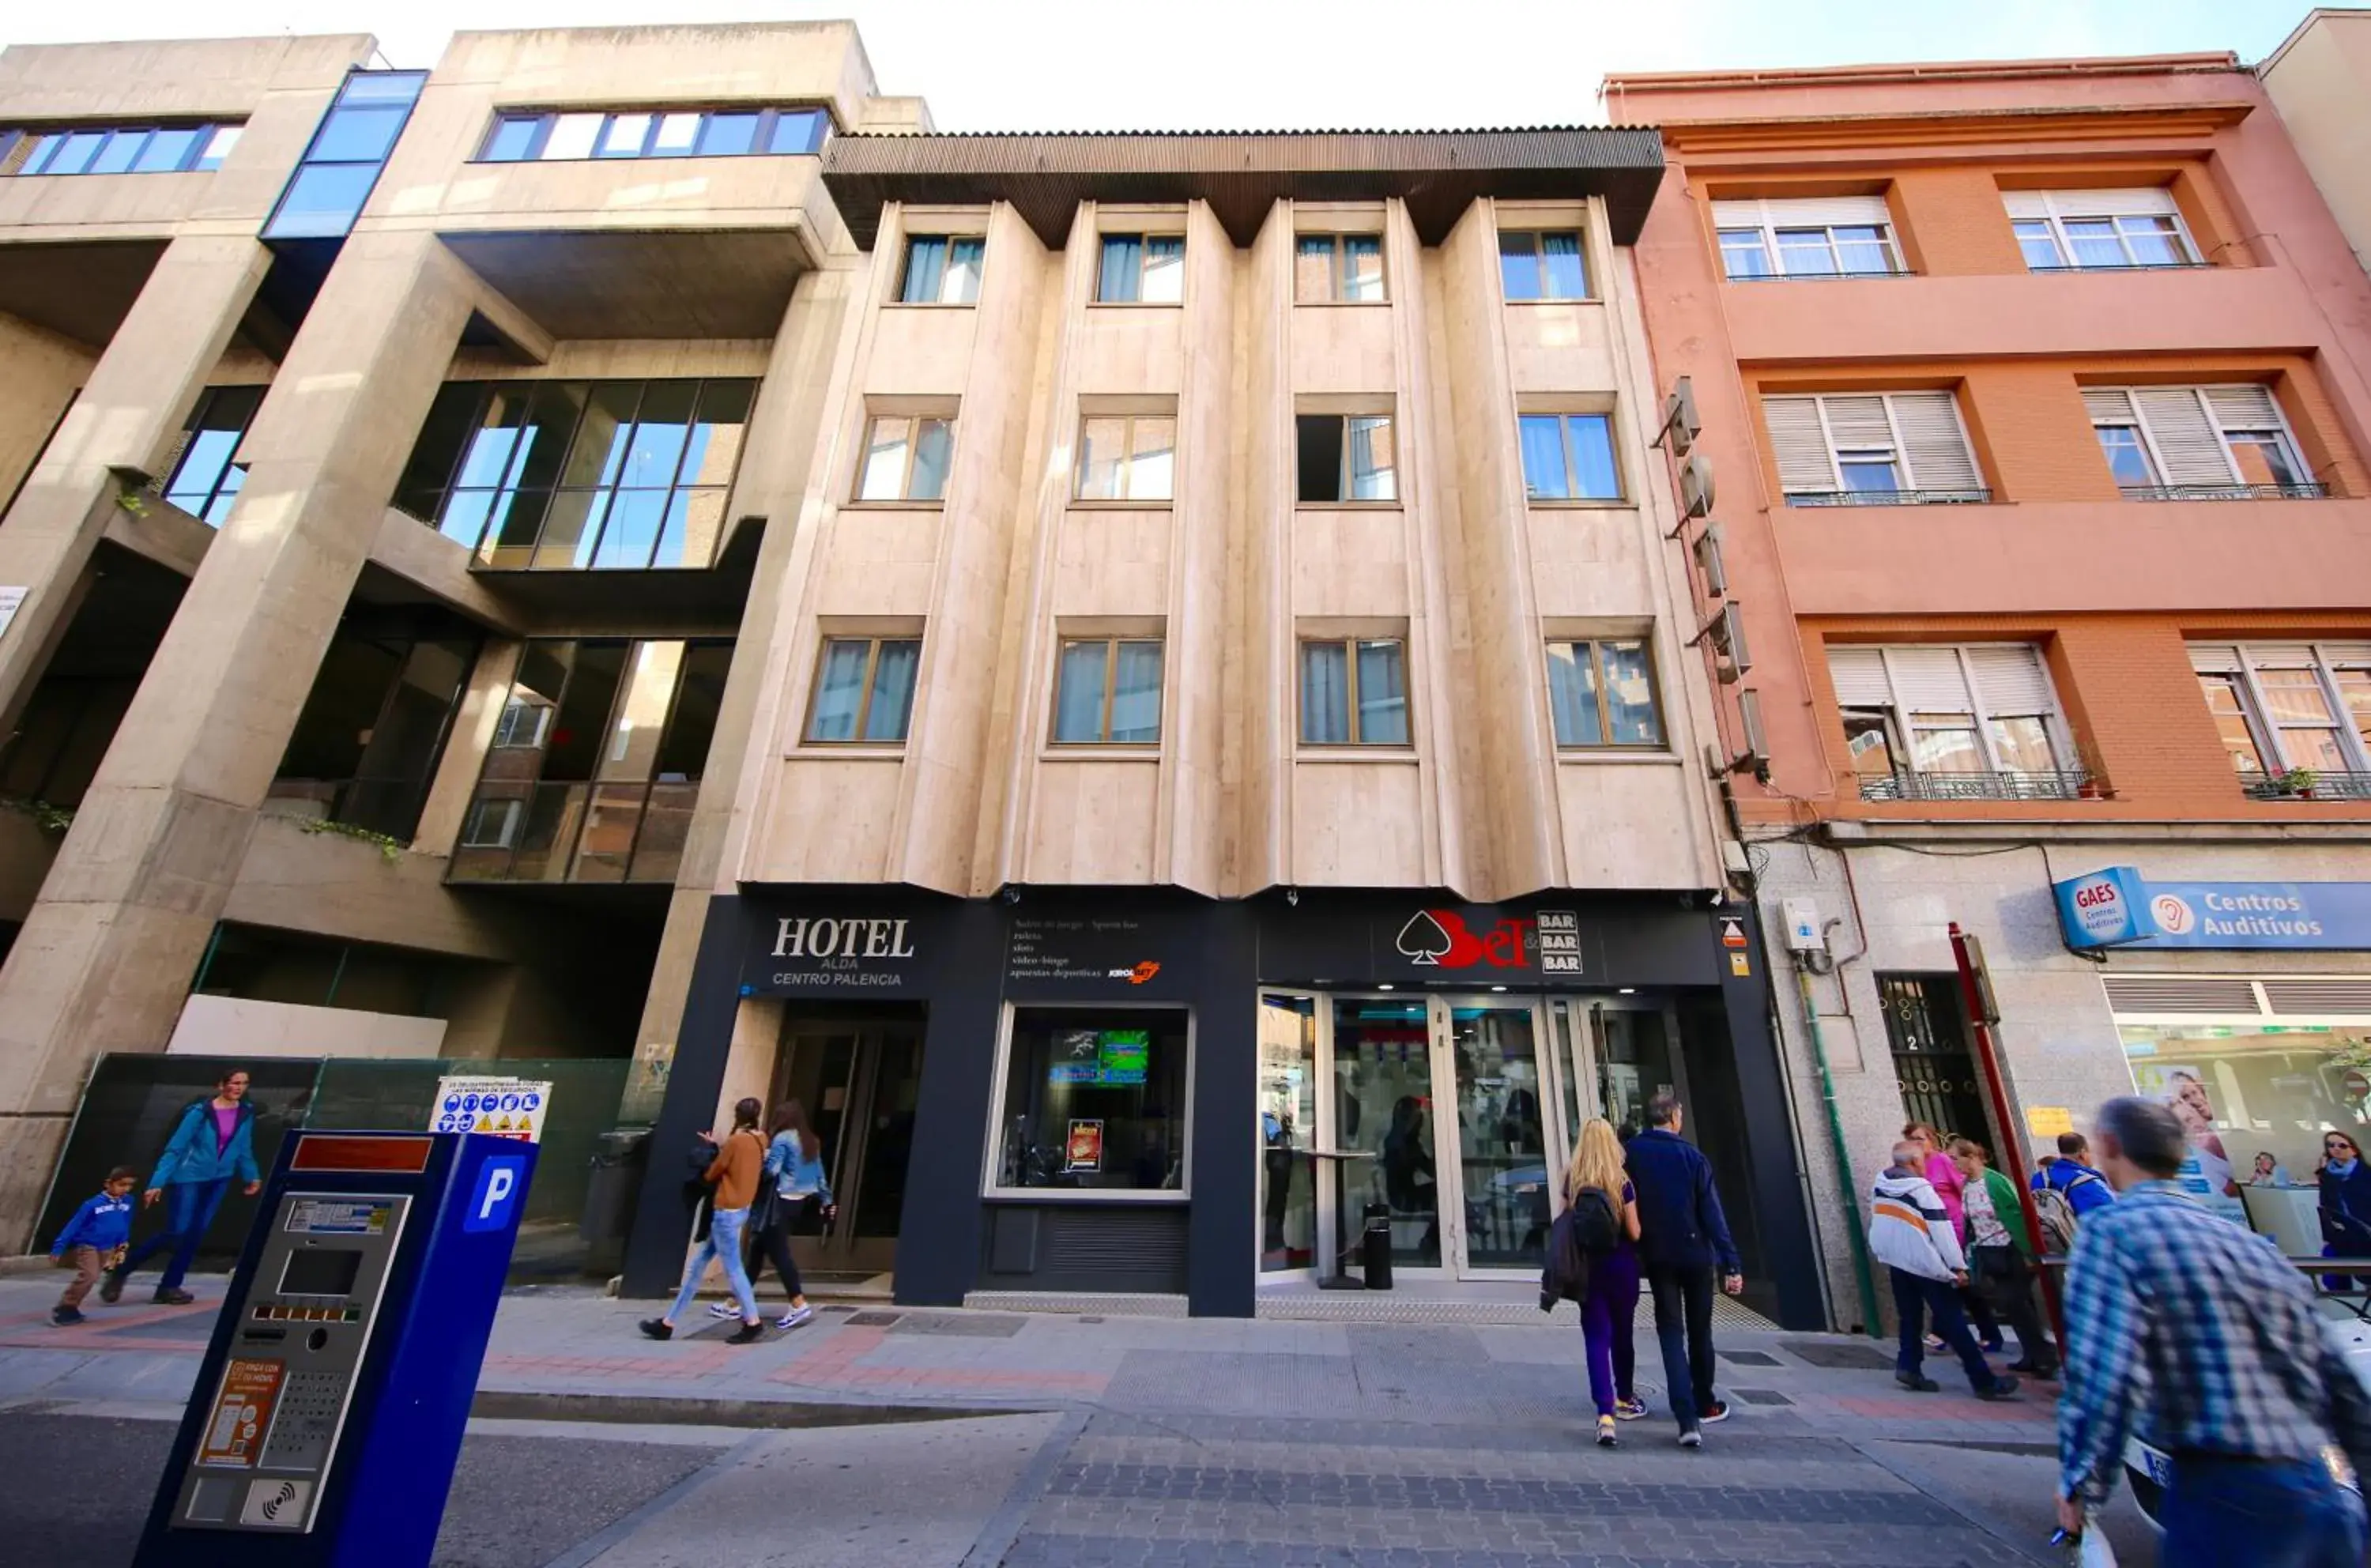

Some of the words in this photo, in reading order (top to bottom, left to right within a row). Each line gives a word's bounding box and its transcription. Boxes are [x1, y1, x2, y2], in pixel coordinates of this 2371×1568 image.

[2076, 883, 2116, 908] GAES
[2205, 893, 2301, 911] Centros
[2086, 906, 2117, 921] Centros
[1541, 915, 1574, 928] BAR
[2086, 917, 2124, 930] Auditivos
[2203, 917, 2323, 936] Auditivos
[771, 918, 914, 957] HOTEL
[1543, 936, 1578, 948] BAR
[820, 959, 858, 970] ALDA
[1544, 956, 1580, 971] BAR
[773, 973, 830, 985] CENTRO
[834, 973, 902, 986] PALENCIA
[1907, 1036, 1918, 1050] 2
[479, 1168, 514, 1219] P
